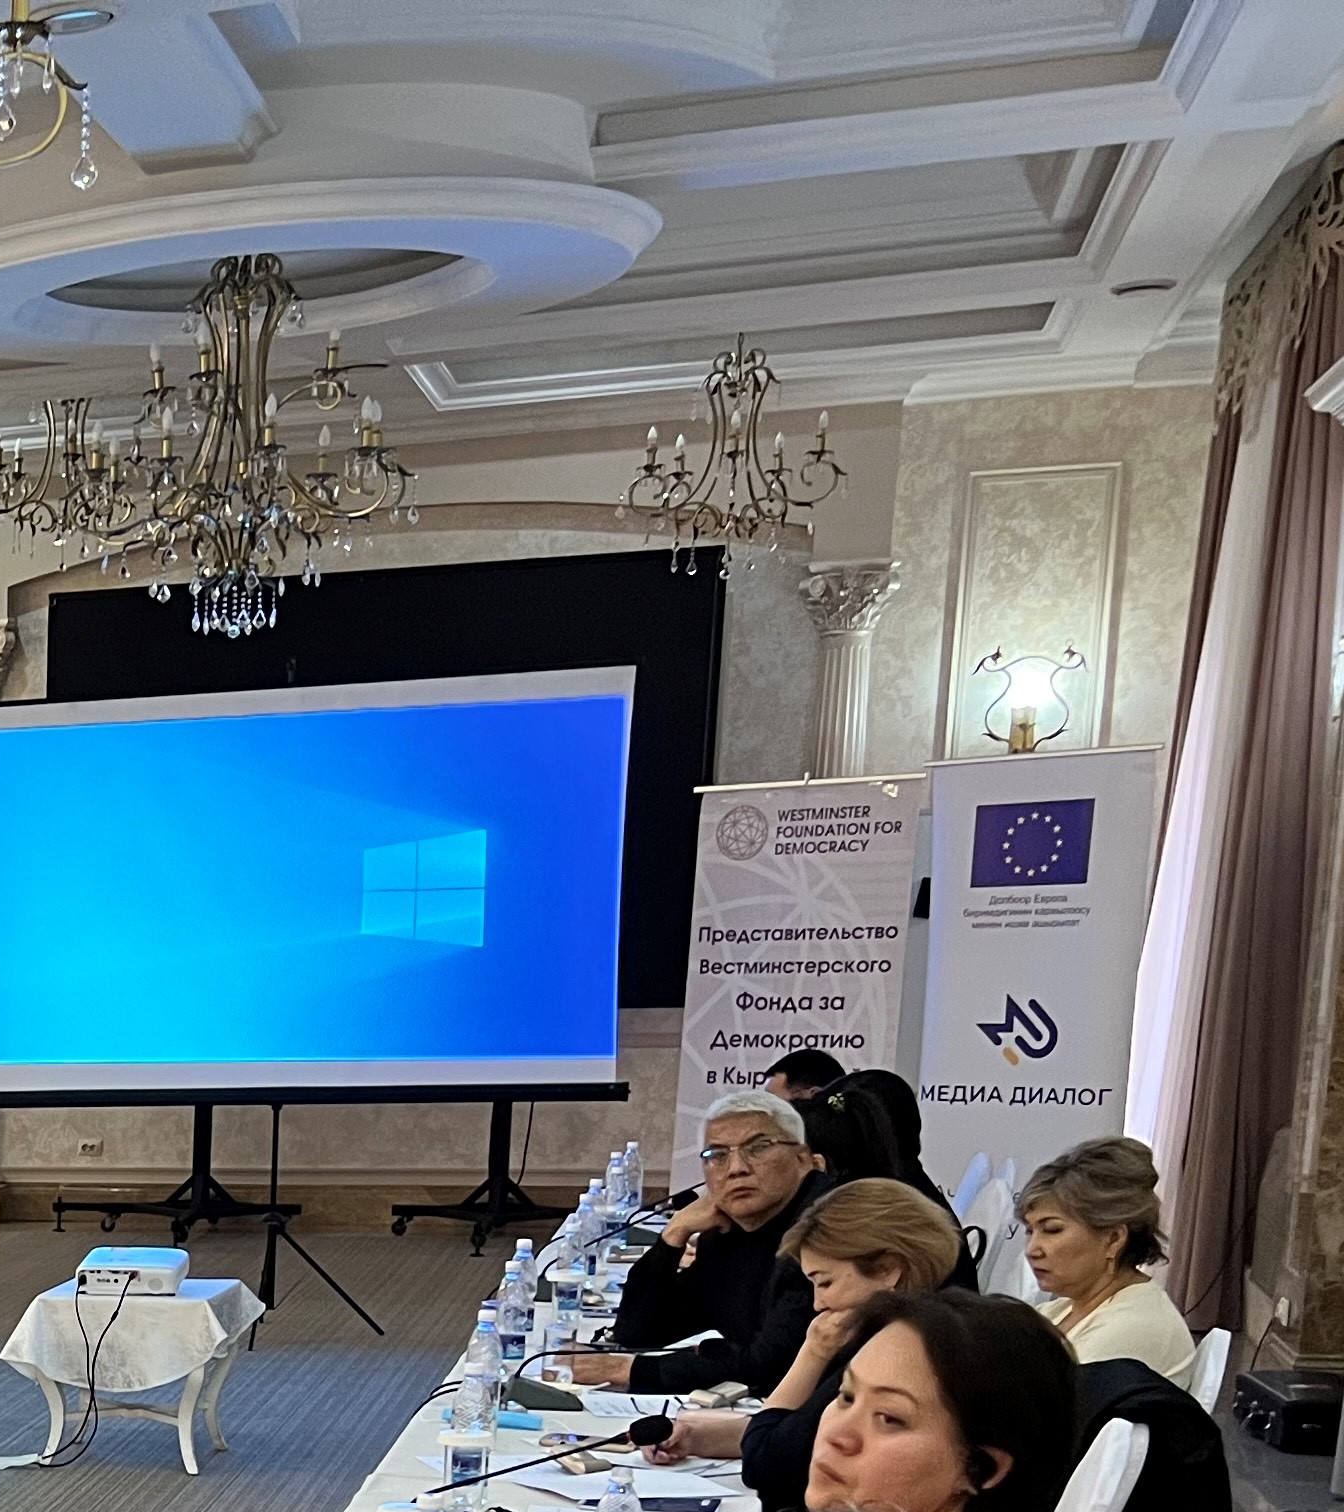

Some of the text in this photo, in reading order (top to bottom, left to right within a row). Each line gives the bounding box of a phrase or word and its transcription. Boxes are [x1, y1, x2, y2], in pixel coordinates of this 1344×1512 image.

[777, 805, 871, 822] WESTMINSTER
[775, 820, 902, 839] FOUNDATION FOR
[774, 839, 870, 855] DEMOCRACY
[698, 925, 899, 946] Представительство
[699, 958, 892, 977] Вестминстерского
[735, 991, 845, 1013] Фонда за
[709, 1029, 865, 1053] Демократию
[706, 1070, 717, 1084] в
[920, 1084, 1113, 1107] МЕДИА ДИАЛОГ
